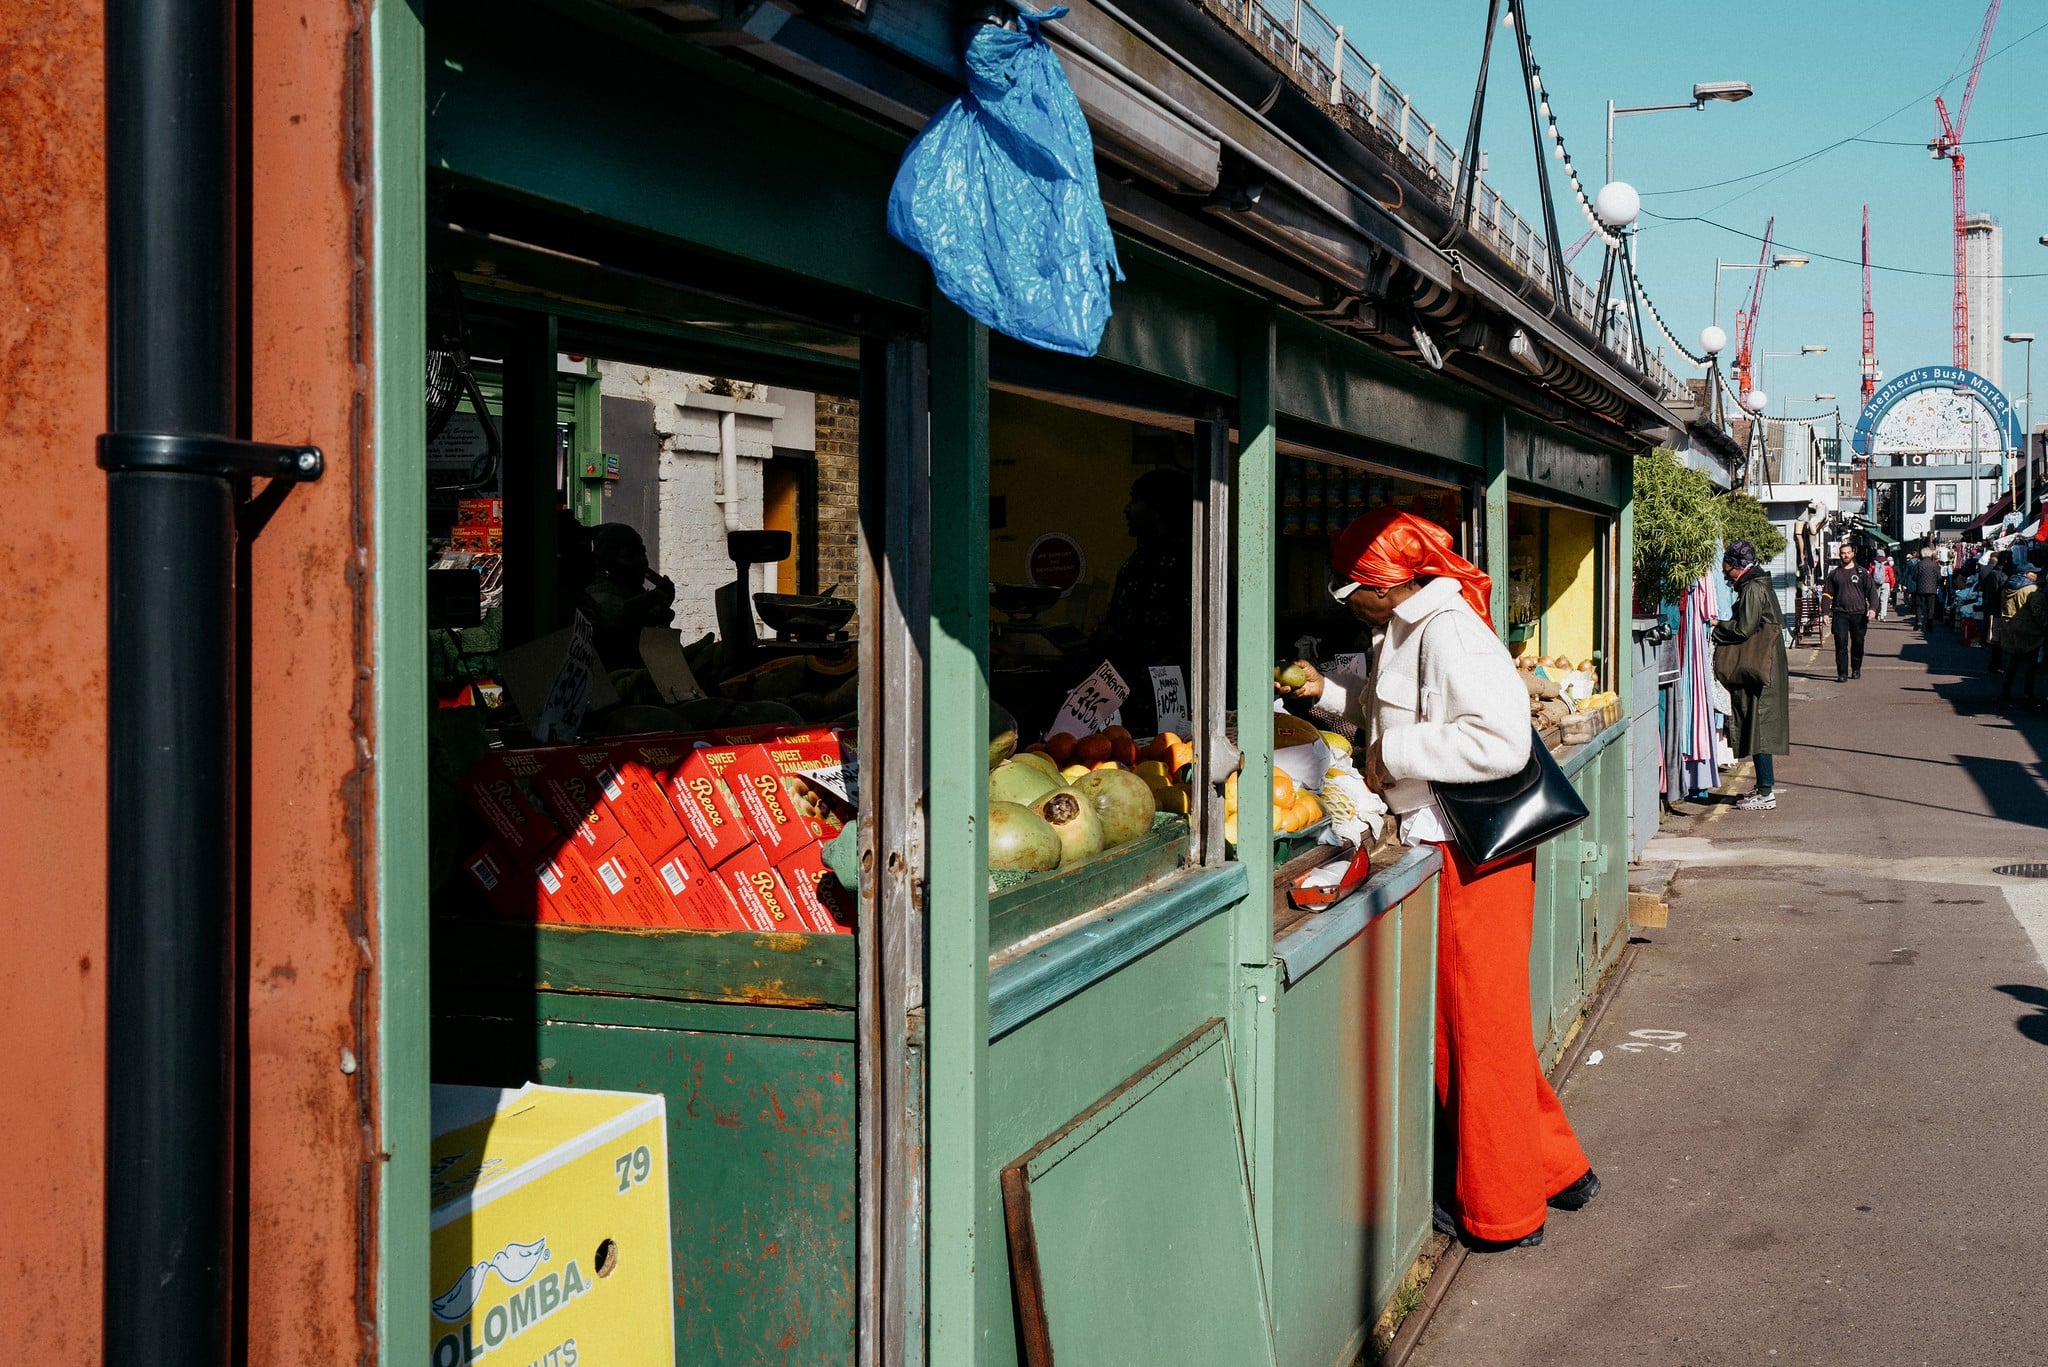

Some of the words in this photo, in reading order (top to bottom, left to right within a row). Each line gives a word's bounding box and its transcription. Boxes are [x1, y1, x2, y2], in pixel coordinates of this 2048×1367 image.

[1865, 370, 1928, 419] Shepherd's
[1934, 369, 1966, 382] Bush
[1971, 376, 2009, 415] Market
[1950, 515, 1970, 523] Hotel
[706, 752, 737, 764] SWEET
[771, 750, 802, 762] SWEET
[777, 759, 822, 774] TAMARIND
[489, 780, 526, 824] Reece
[564, 777, 599, 824] Reece
[690, 777, 723, 827] Reece
[754, 774, 787, 825] Reece
[751, 871, 785, 921] Reece
[811, 870, 843, 921] Reece
[616, 1146, 651, 1192] 79
[433, 1260, 585, 1367] OLOMBA
